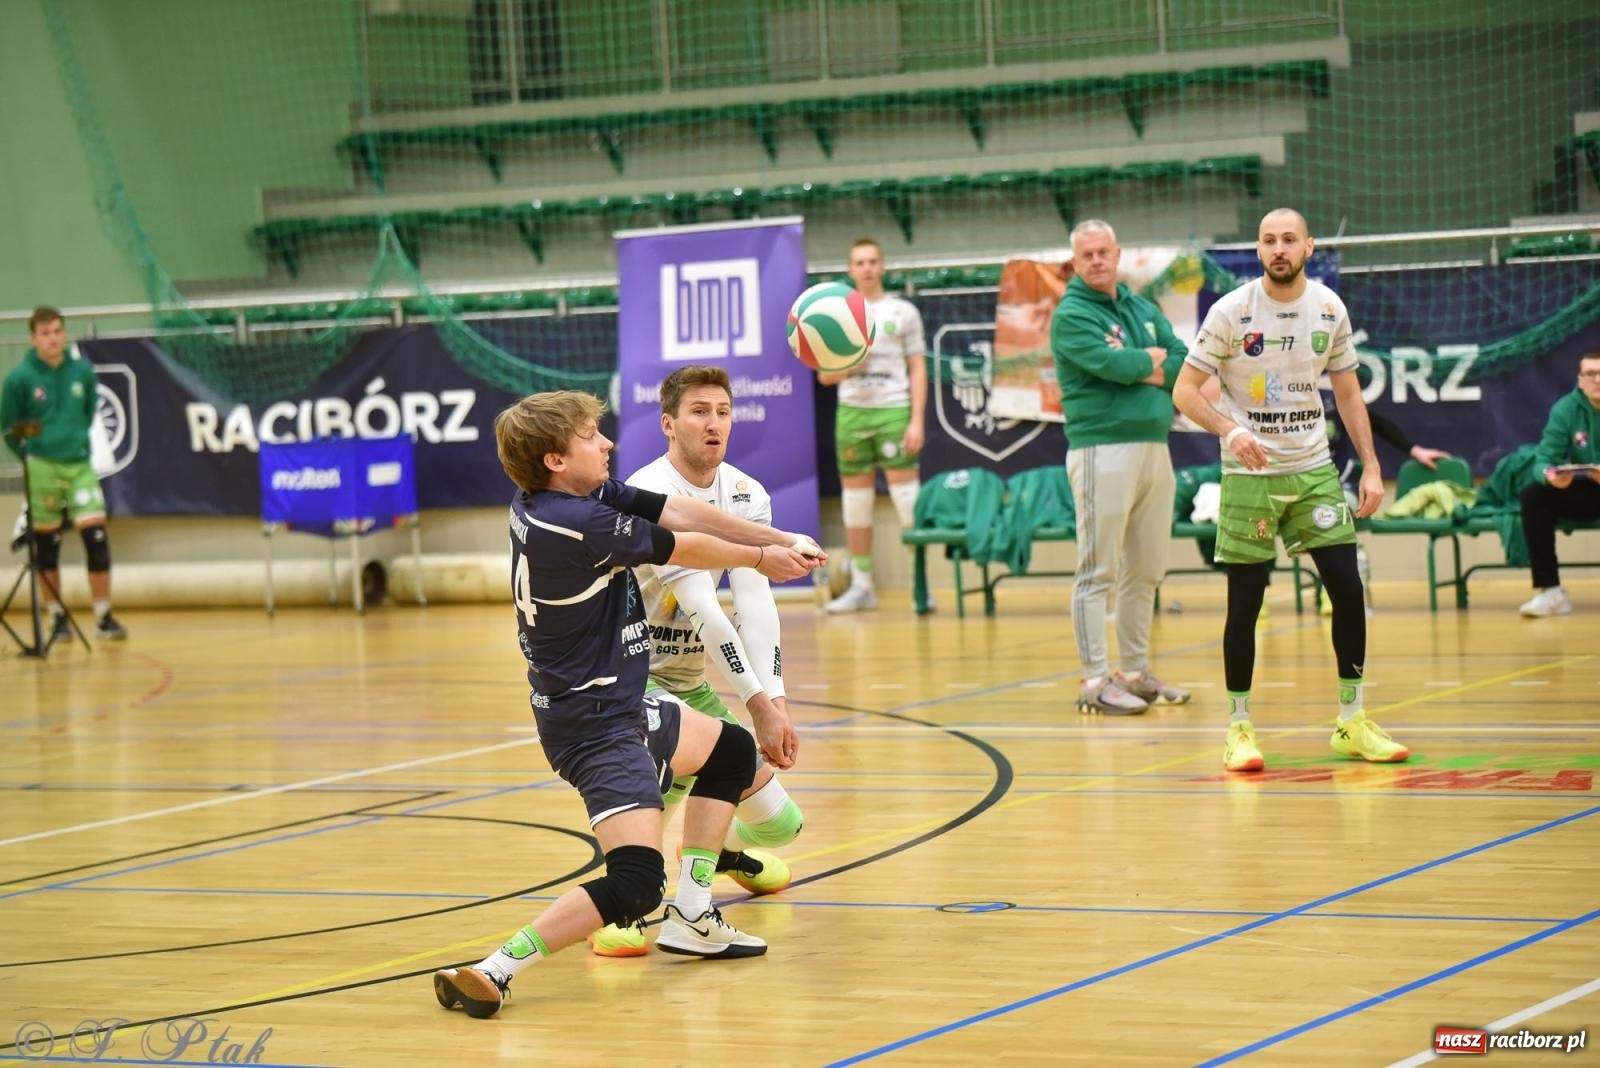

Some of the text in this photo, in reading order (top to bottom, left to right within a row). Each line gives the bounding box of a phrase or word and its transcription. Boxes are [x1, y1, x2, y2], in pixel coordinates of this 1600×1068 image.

[660, 258, 763, 361] bmp
[1281, 336, 1295, 351] 77
[1352, 329, 1482, 404] ÓRZ
[1287, 382, 1316, 393] GUA
[185, 376, 480, 453] RACIBÓRZ
[512, 545, 538, 627] 4
[628, 639, 650, 656] 605
[655, 645, 705, 656] 605 944
